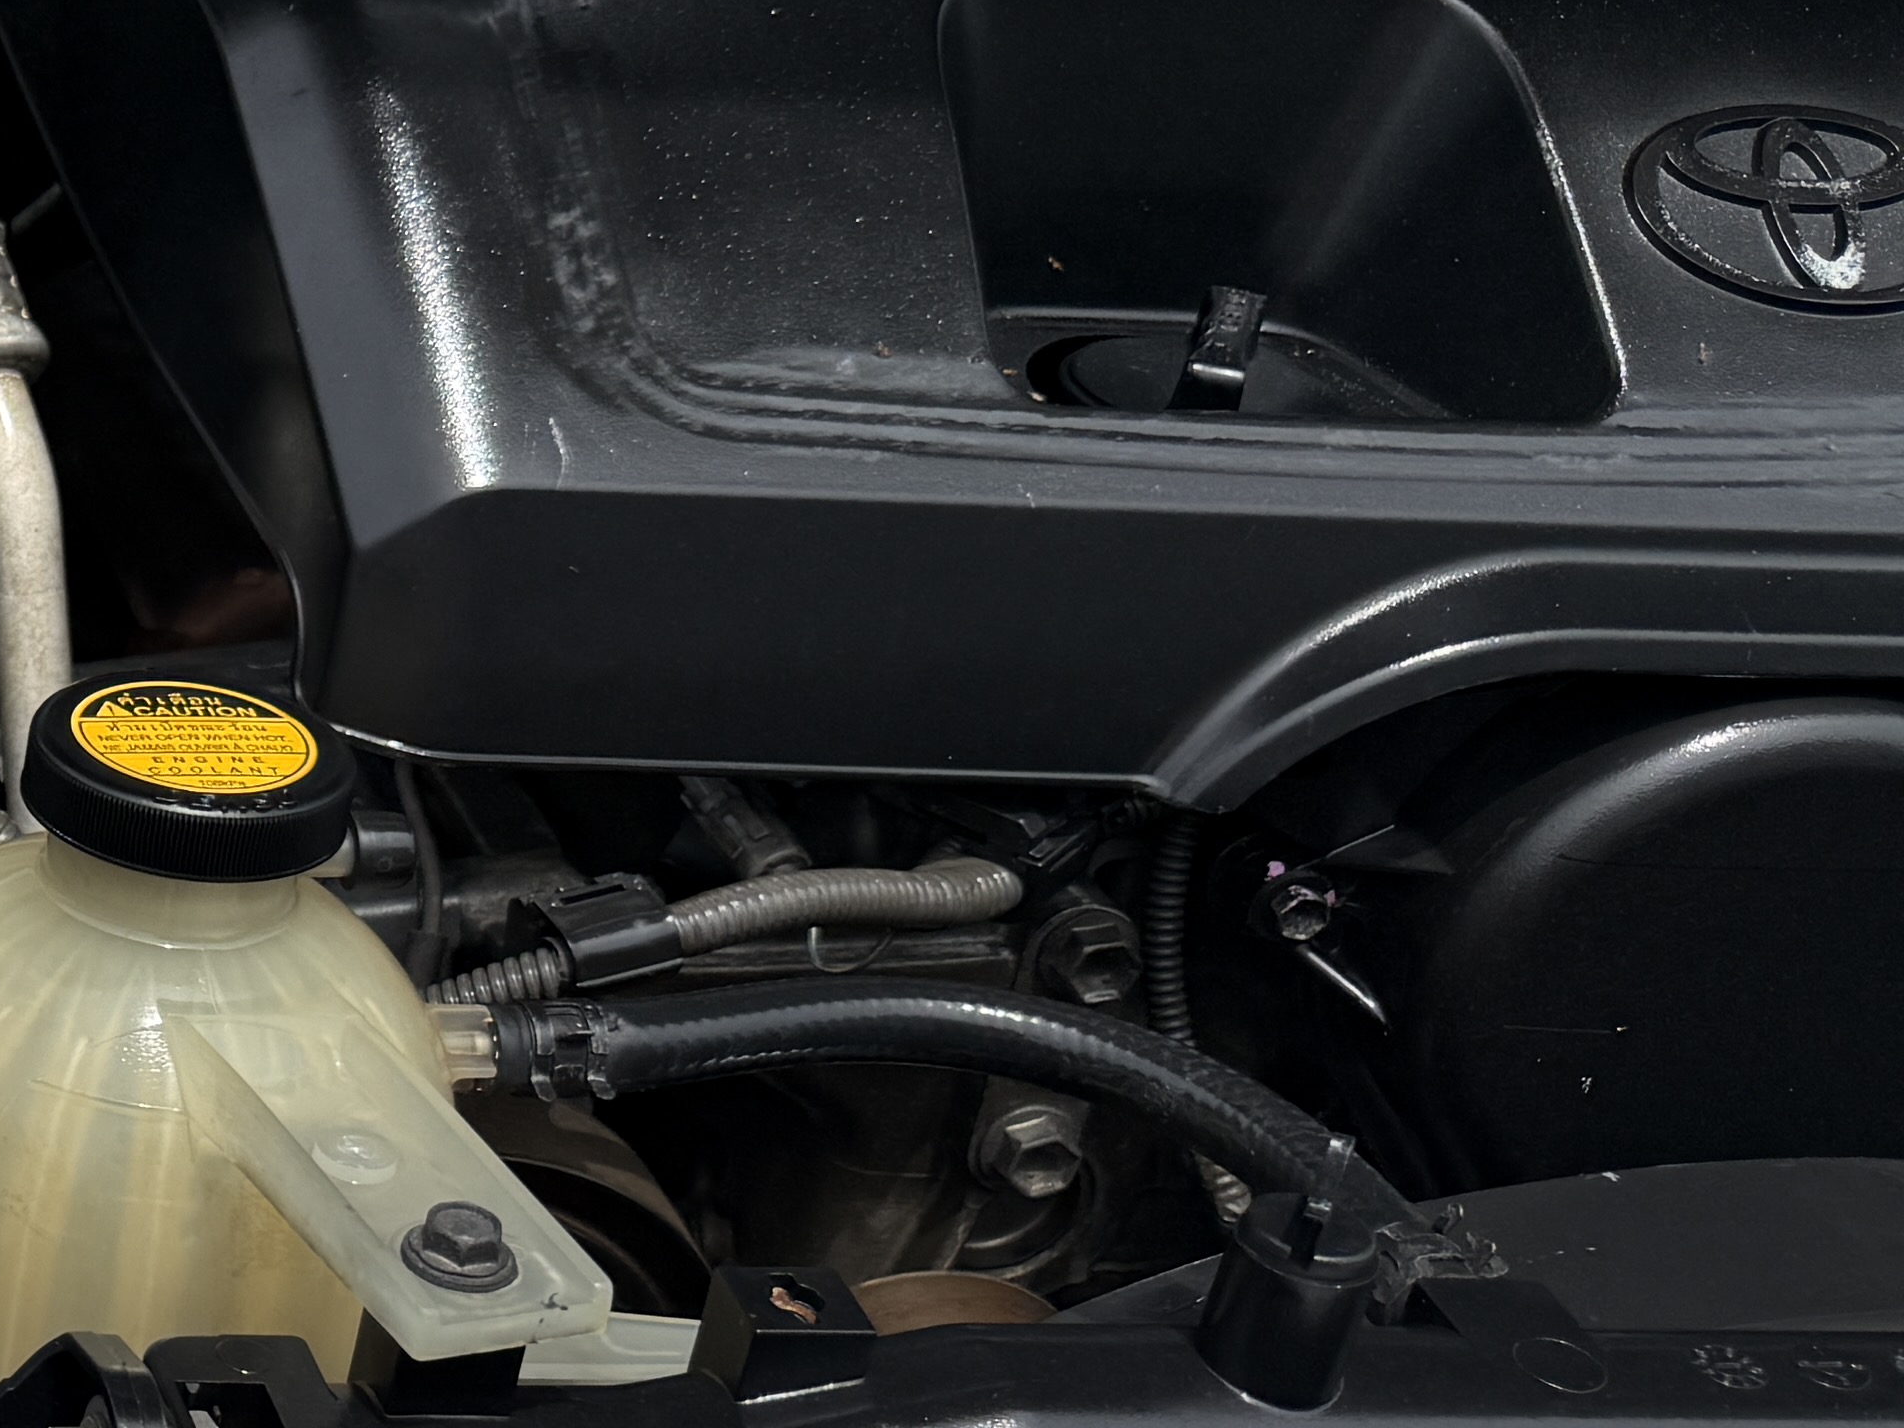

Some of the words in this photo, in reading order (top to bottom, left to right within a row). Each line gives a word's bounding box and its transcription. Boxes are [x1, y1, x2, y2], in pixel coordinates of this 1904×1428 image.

[133, 706, 258, 718] CAUTION
[98, 733, 153, 742] NEVER
[155, 733, 202, 742] OPEN
[205, 734, 250, 742] WHEN
[151, 755, 265, 764] ENGINE
[147, 766, 280, 776] COOLANT
